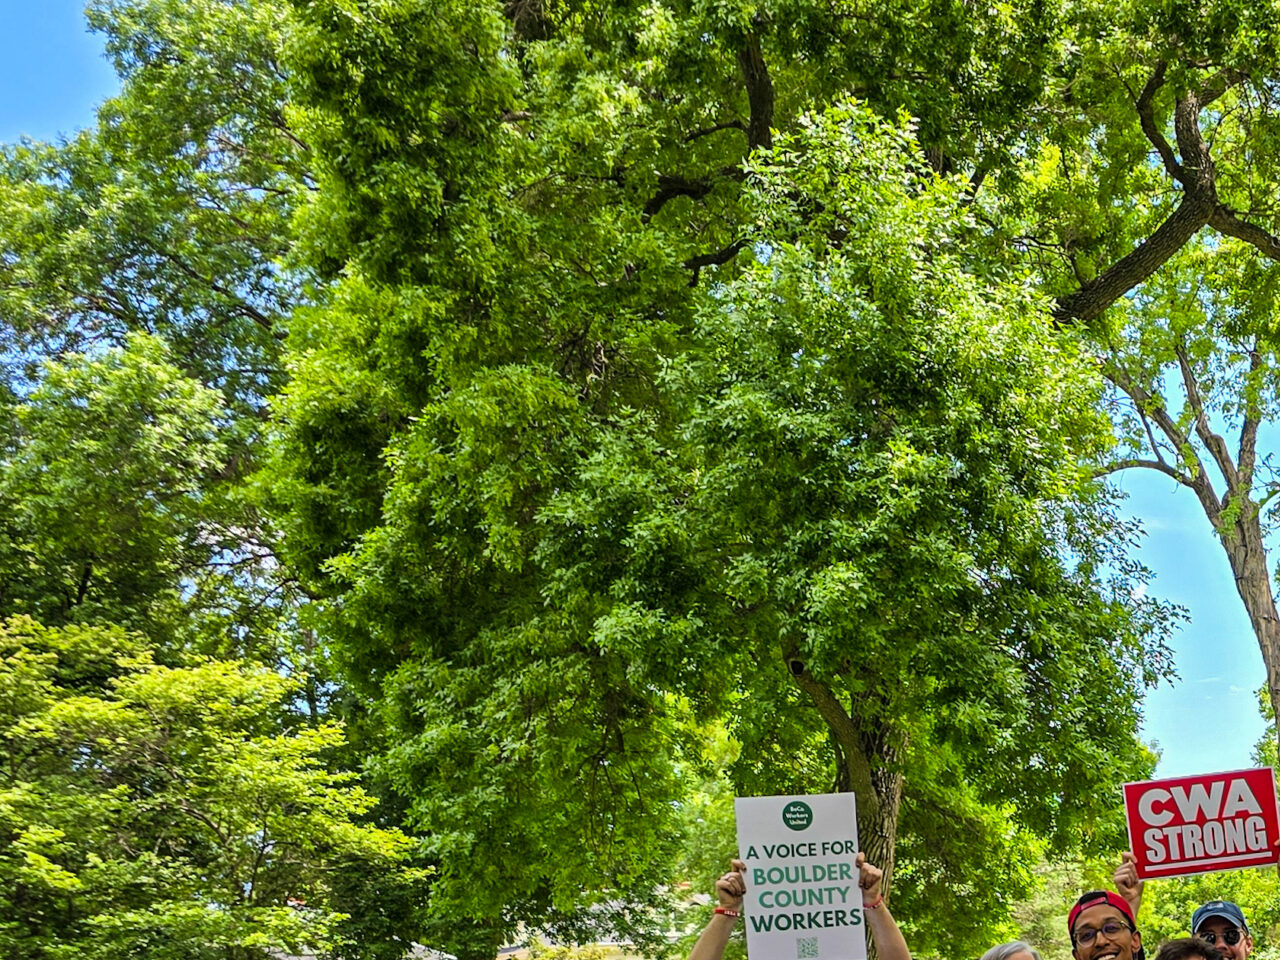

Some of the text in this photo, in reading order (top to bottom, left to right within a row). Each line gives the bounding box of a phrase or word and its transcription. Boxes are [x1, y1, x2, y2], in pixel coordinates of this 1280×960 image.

[1138, 778, 1263, 827] CWA
[746, 840, 856, 860] A VOICE FOR
[1143, 815, 1268, 863] STRONG
[753, 862, 854, 886] BOULDER
[758, 886, 851, 908] COUNTY
[750, 908, 862, 932] WORKERS
